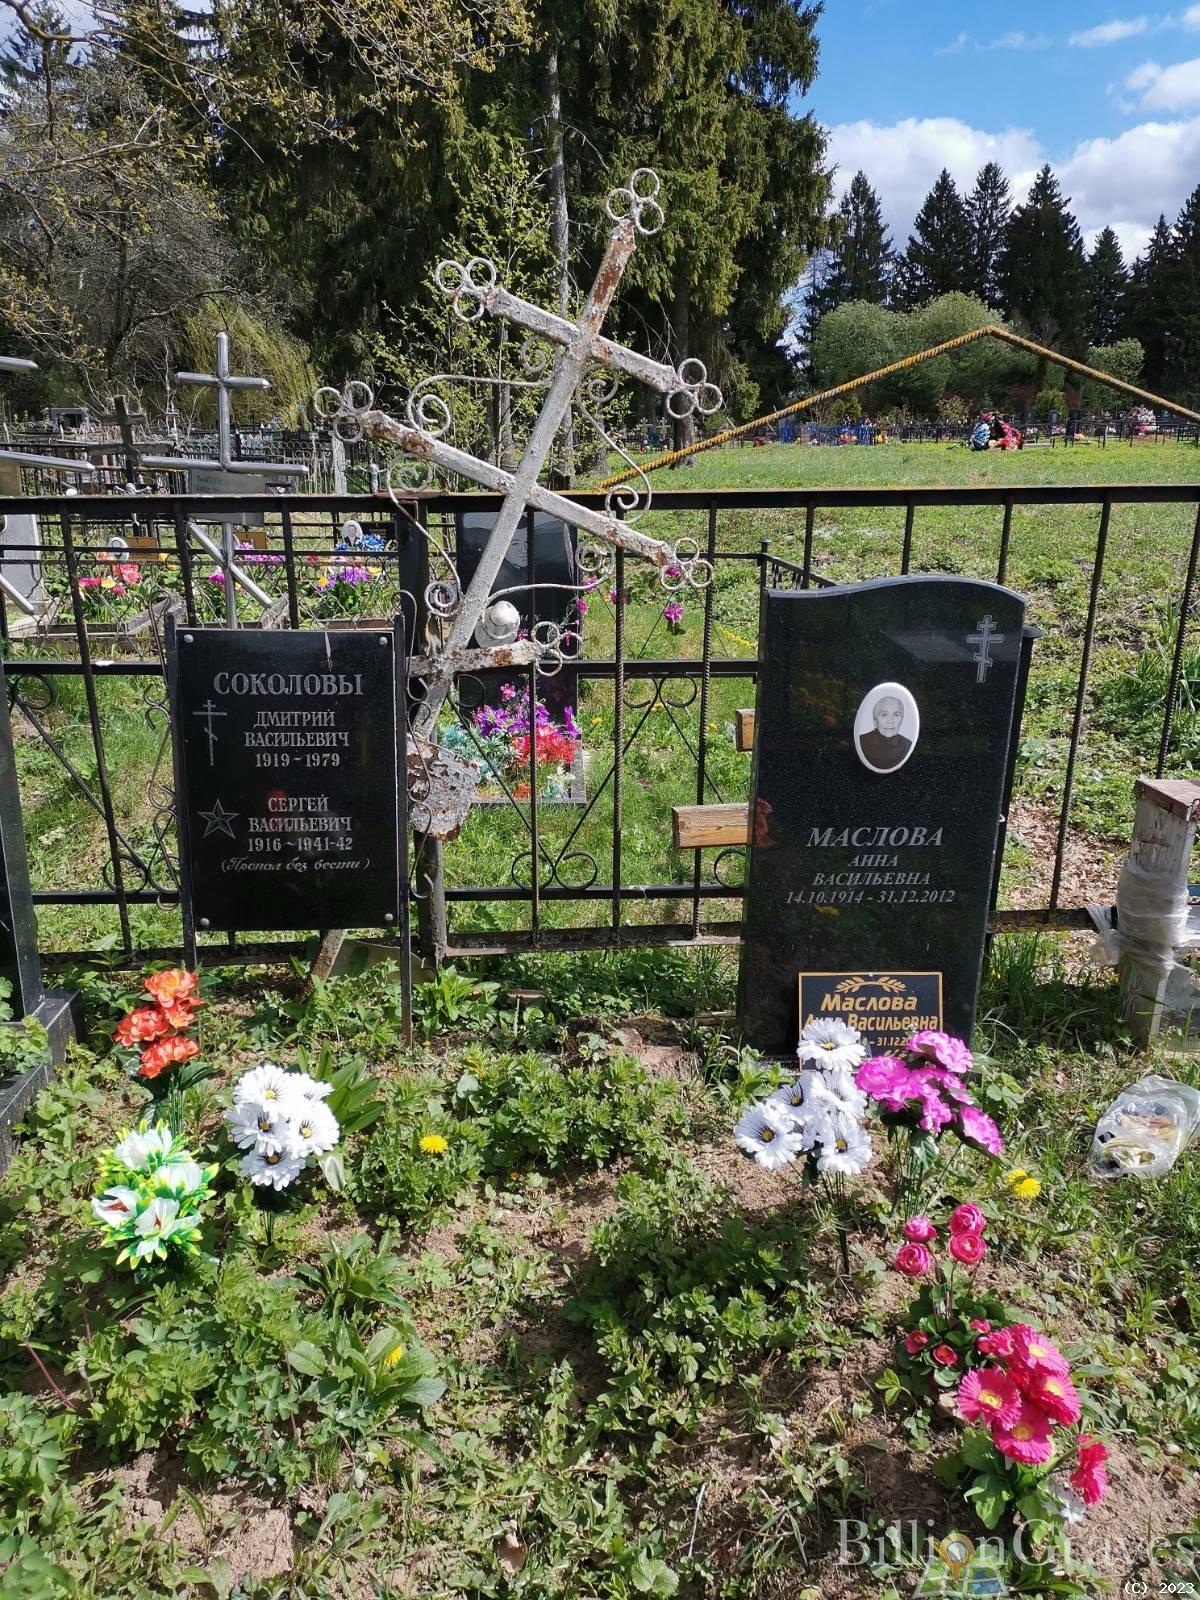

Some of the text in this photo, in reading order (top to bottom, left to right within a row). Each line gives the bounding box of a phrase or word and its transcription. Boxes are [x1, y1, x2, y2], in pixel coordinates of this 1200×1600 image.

[213, 672, 364, 696] СОКОЛОВЫ
[253, 709, 336, 729] ДМИТРИЙ
[244, 732, 350, 747] ВАСИЛЬЕВИЧ
[267, 793, 330, 812] СЕРГЕЙ
[247, 816, 353, 833] ВАСИЛЬЕВИЧ
[806, 826, 944, 847] МАСЛОВА
[285, 856, 308, 873] без
[848, 854, 899, 867] АННА
[812, 872, 931, 886] ВАСИЛЬЕВНА
[784, 890, 865, 904] 14.10.1914
[877, 890, 956, 903] 31.12.2012
[820, 993, 918, 1012] Маслова
[847, 1013, 939, 1031] Васильевна
